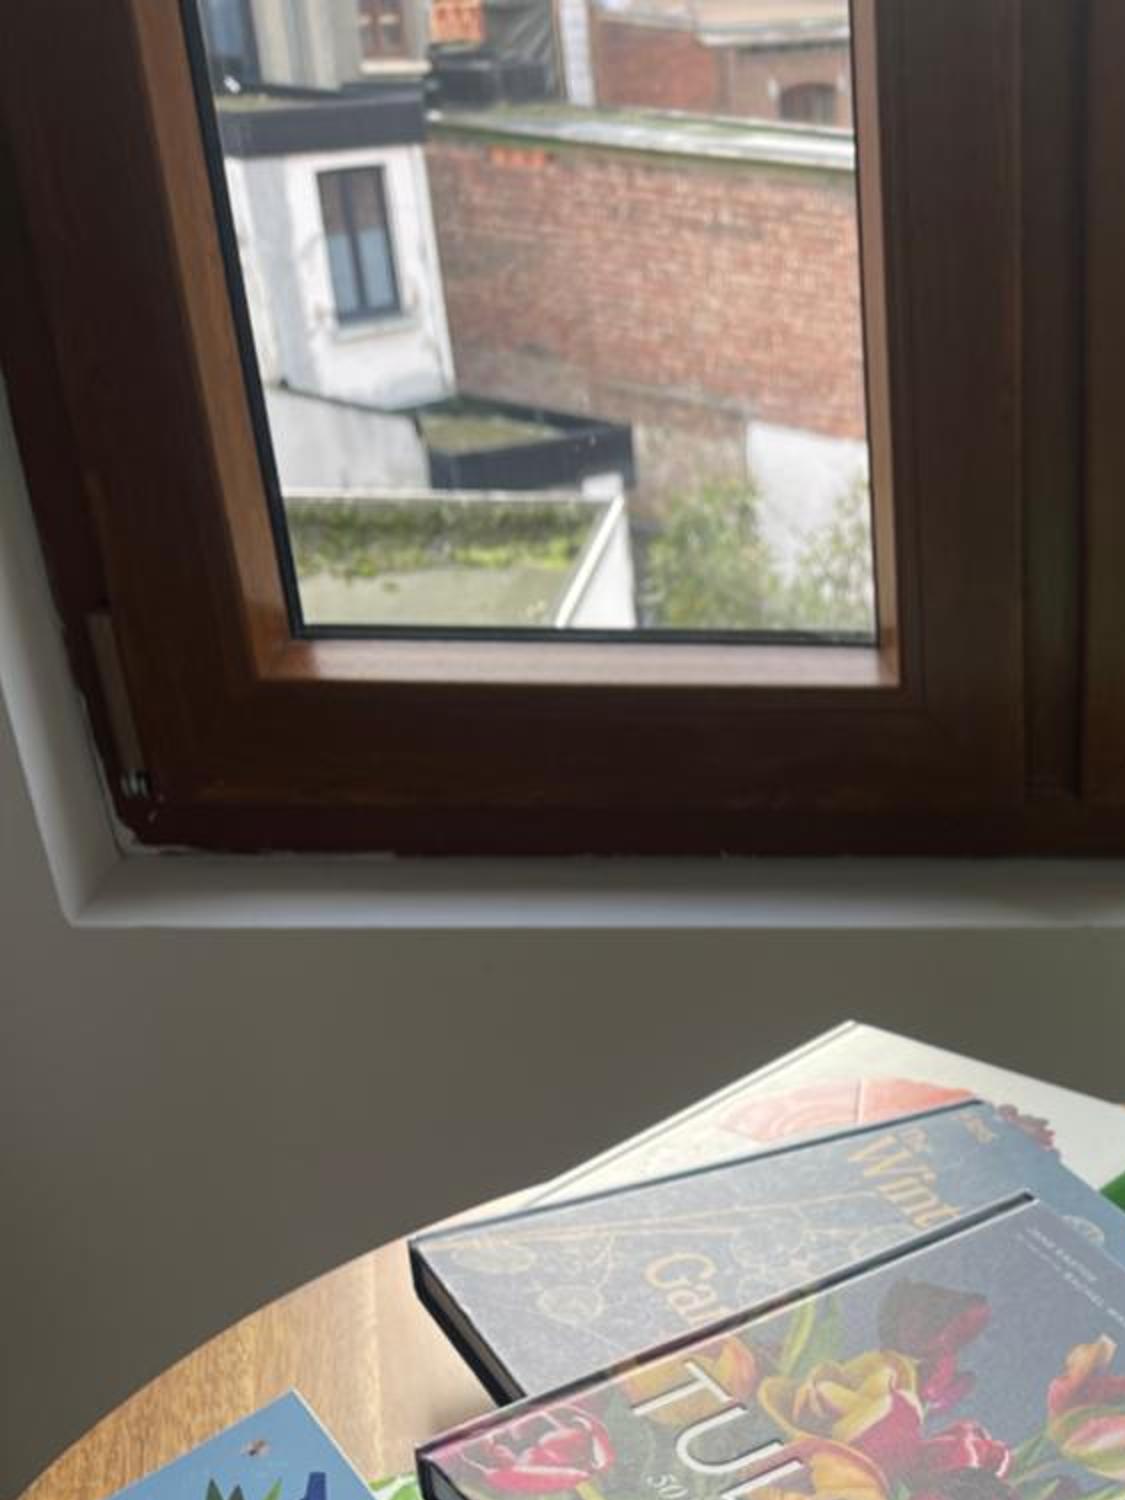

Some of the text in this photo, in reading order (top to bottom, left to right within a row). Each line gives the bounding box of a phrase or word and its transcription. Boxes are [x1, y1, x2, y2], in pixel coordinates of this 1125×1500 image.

[848, 1133, 962, 1231] Wint
[644, 1252, 735, 1328] Gar
[647, 1474, 689, 1500] 50
